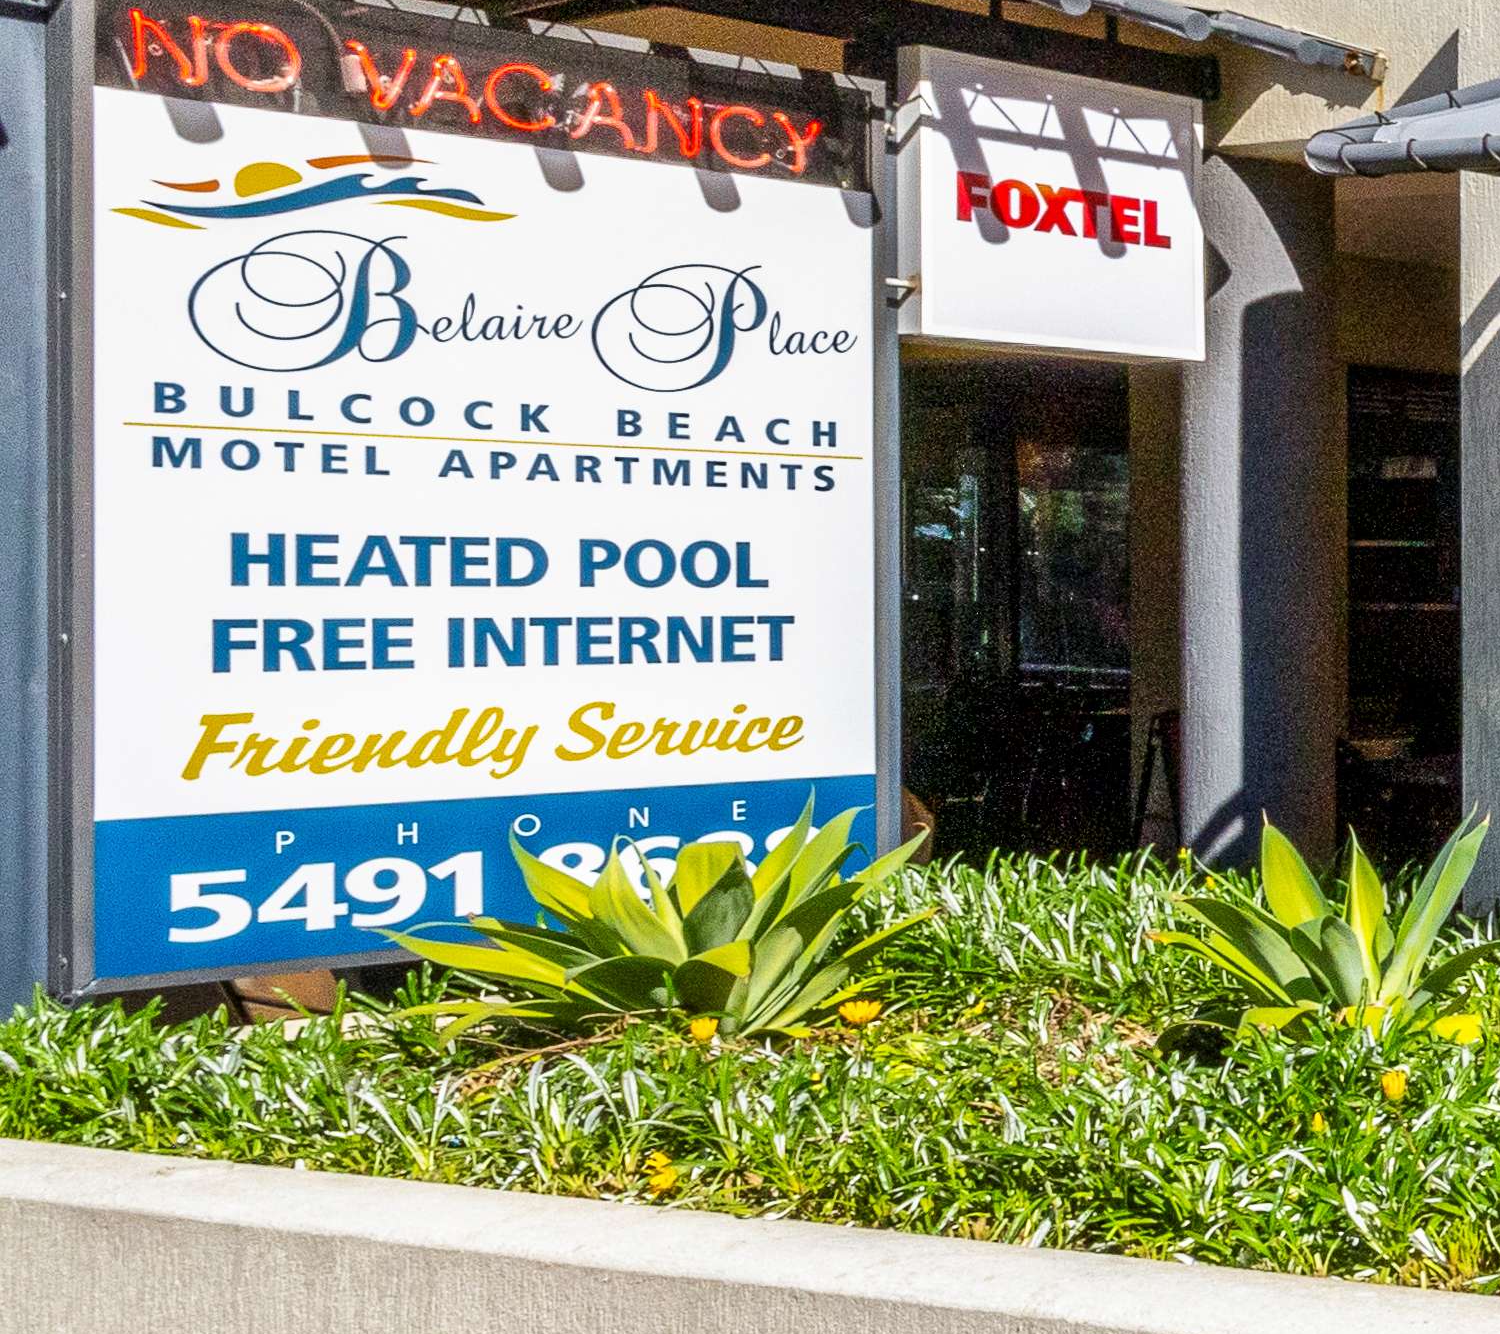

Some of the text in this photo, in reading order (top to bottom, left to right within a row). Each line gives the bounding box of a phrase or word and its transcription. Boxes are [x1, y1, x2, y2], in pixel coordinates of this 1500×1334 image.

[128, 7, 823, 173] NO VACANCY
[956, 170, 1172, 249] FOXTEL
[188, 230, 858, 392] Belaire Place
[153, 381, 838, 448] BULCOCK BEACH
[152, 436, 836, 492] MOTEL APARTMENTS
[230, 532, 770, 588] HEATED POOL
[212, 615, 796, 673] FREE INTERNET
[181, 701, 805, 781] Friendly Service
[275, 799, 747, 855] PHONE
[168, 850, 484, 943] 5491
